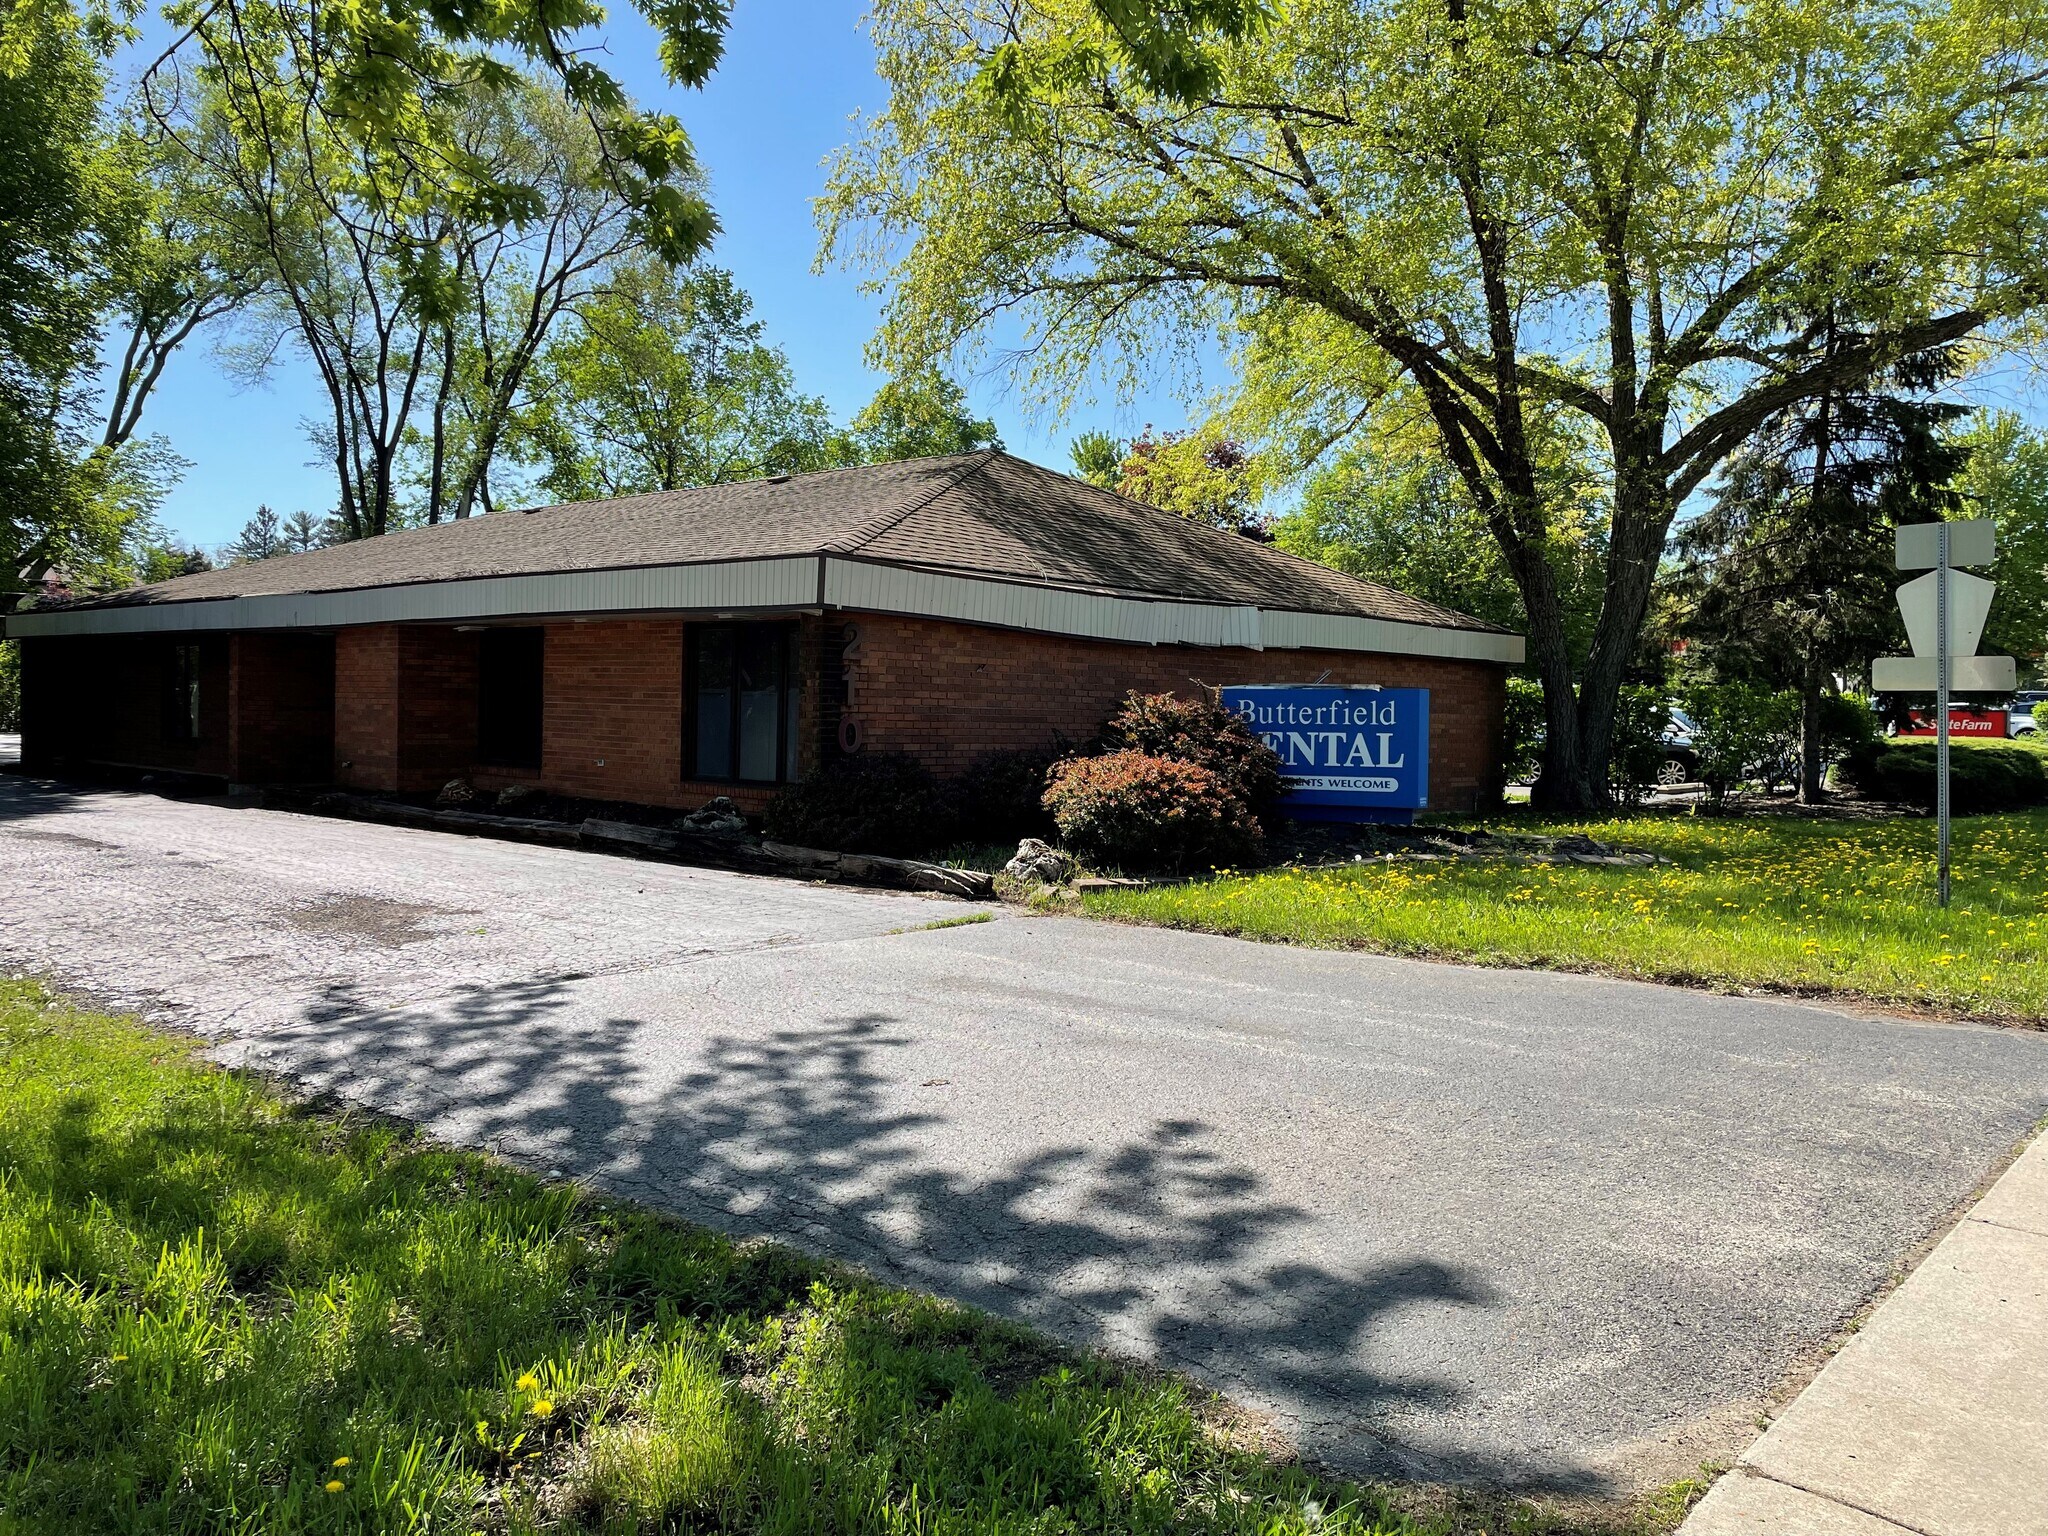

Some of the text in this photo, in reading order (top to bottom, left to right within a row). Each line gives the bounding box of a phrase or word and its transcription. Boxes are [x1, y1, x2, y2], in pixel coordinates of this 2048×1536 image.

[839, 622, 866, 753] 210
[1238, 699, 1396, 725] Butterfield
[1929, 719, 1992, 730] SteFarm
[1258, 732, 1404, 768] ENTAL
[1328, 779, 1390, 789] WELCOME
